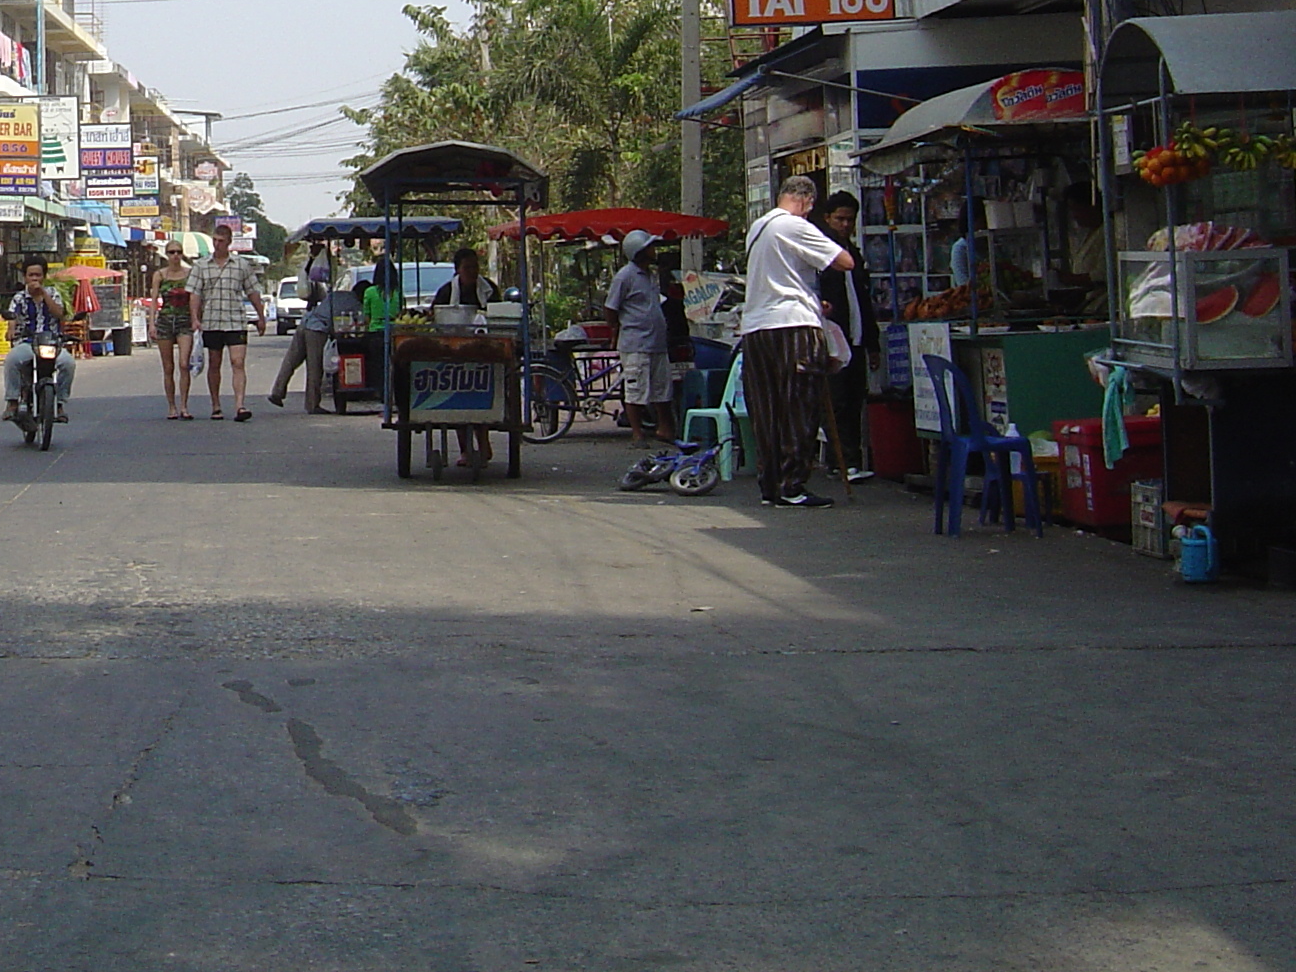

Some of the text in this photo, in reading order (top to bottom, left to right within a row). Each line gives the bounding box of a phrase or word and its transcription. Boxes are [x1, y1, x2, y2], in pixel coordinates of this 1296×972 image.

[13, 122, 32, 136] BAR
[82, 150, 130, 166] GUEST HOUSE
